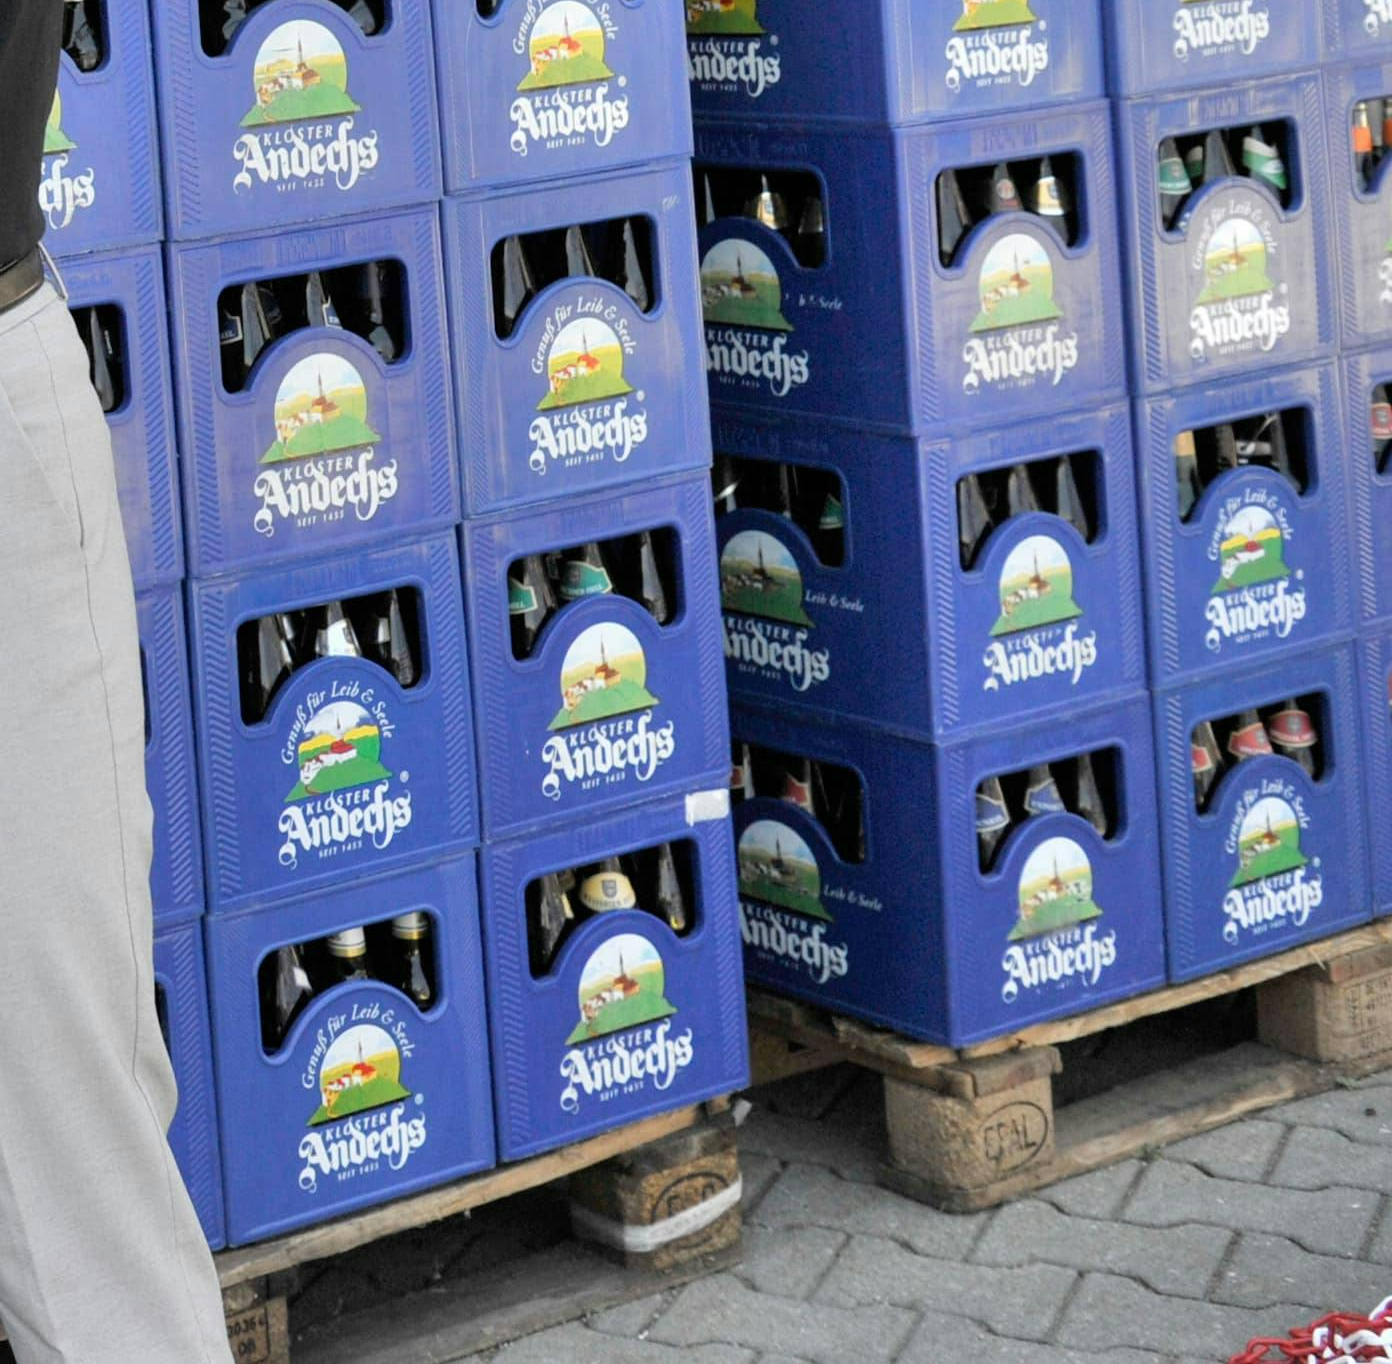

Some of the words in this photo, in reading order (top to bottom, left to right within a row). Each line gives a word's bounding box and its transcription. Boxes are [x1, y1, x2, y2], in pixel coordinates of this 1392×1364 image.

[510, 82, 628, 156] Andechs
[535, 89, 591, 108] KLOSTER
[233, 116, 377, 201] Andechs
[264, 124, 333, 146] KLOSTER
[529, 397, 646, 475] Andechs
[554, 405, 610, 427] KLOSTER
[254, 446, 397, 537] Andechs
[285, 455, 353, 481] KLOSTER
[542, 709, 673, 801] Andechs
[570, 719, 633, 746] KLOSTER
[278, 779, 410, 869] Andechs
[307, 788, 370, 816] KLOSTER
[560, 1018, 692, 1114] Andechs
[588, 1028, 651, 1059] KLOSTER
[299, 1102, 425, 1193] Andechs
[326, 1112, 386, 1141] KLOSTER
